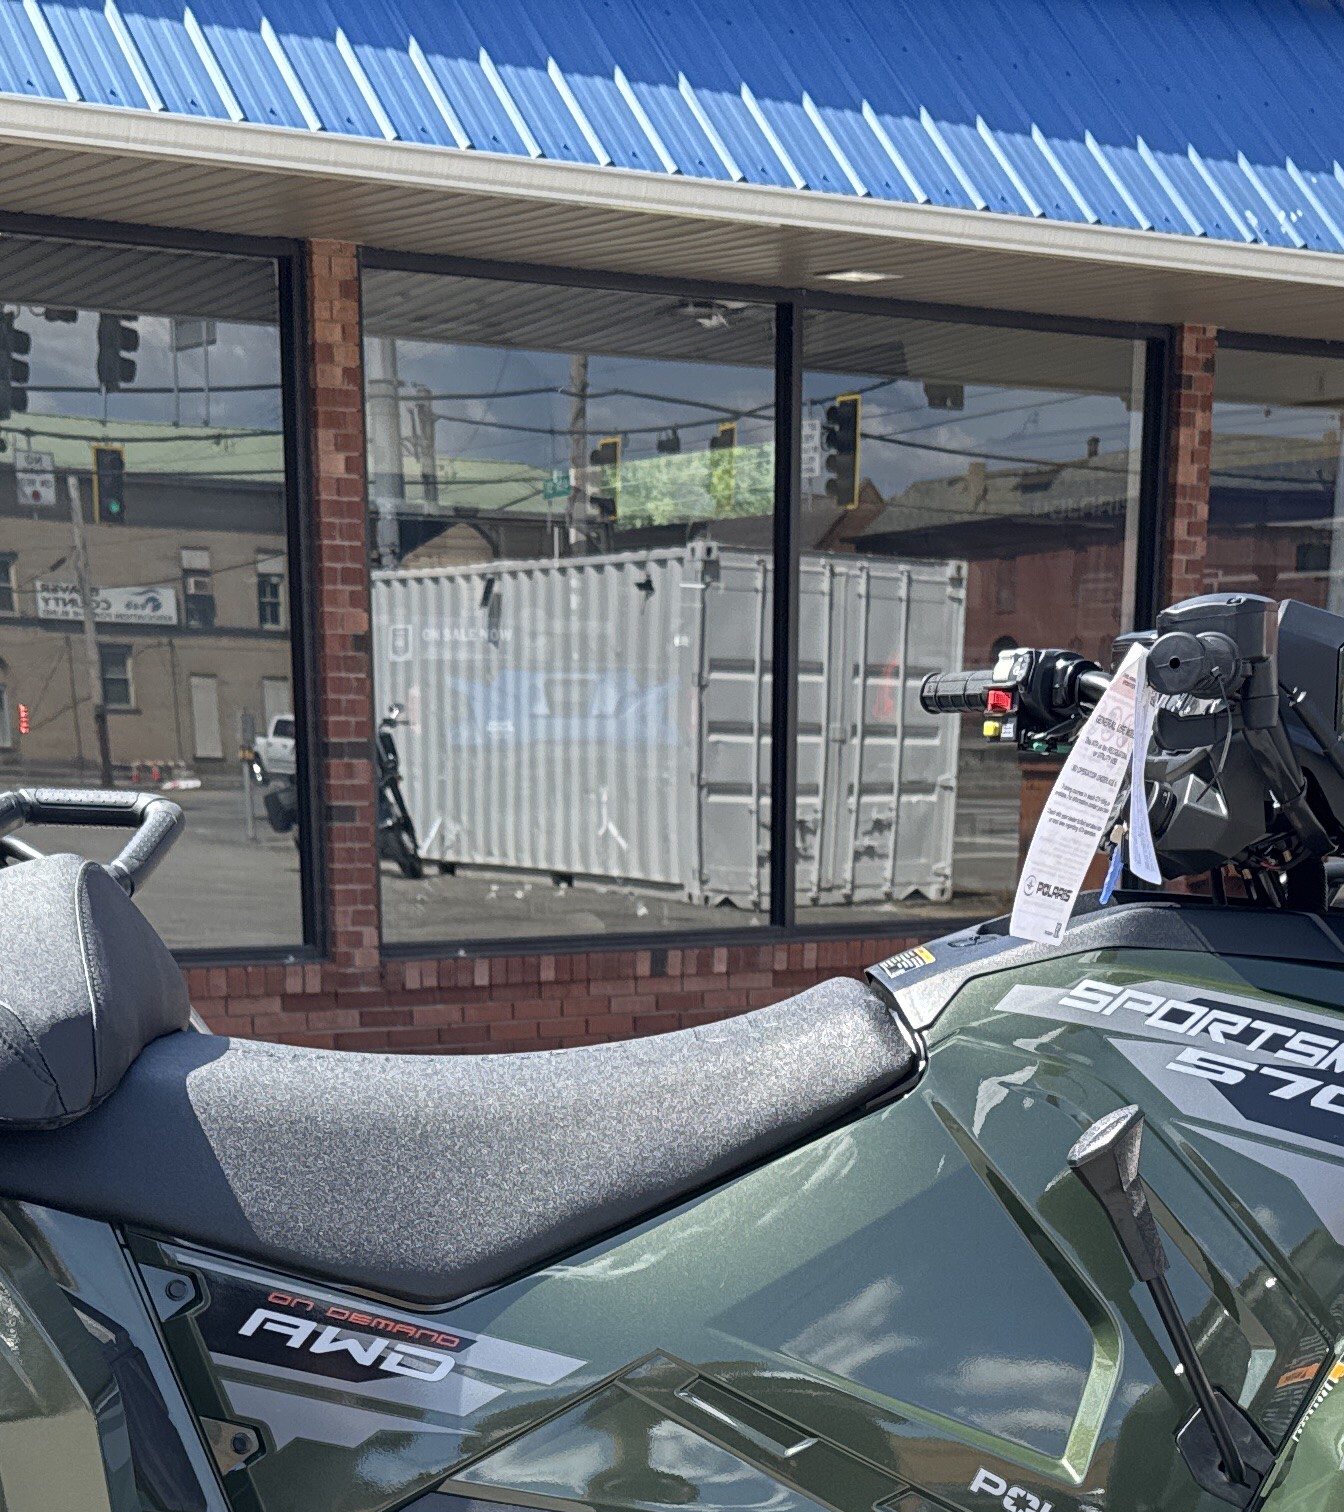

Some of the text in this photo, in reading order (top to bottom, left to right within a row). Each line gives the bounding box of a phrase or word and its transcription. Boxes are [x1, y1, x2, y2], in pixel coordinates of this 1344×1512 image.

[1036, 881, 1074, 903] POLARIS
[238, 1308, 456, 1382] AWD
[268, 1291, 460, 1348] ON DEMAND
